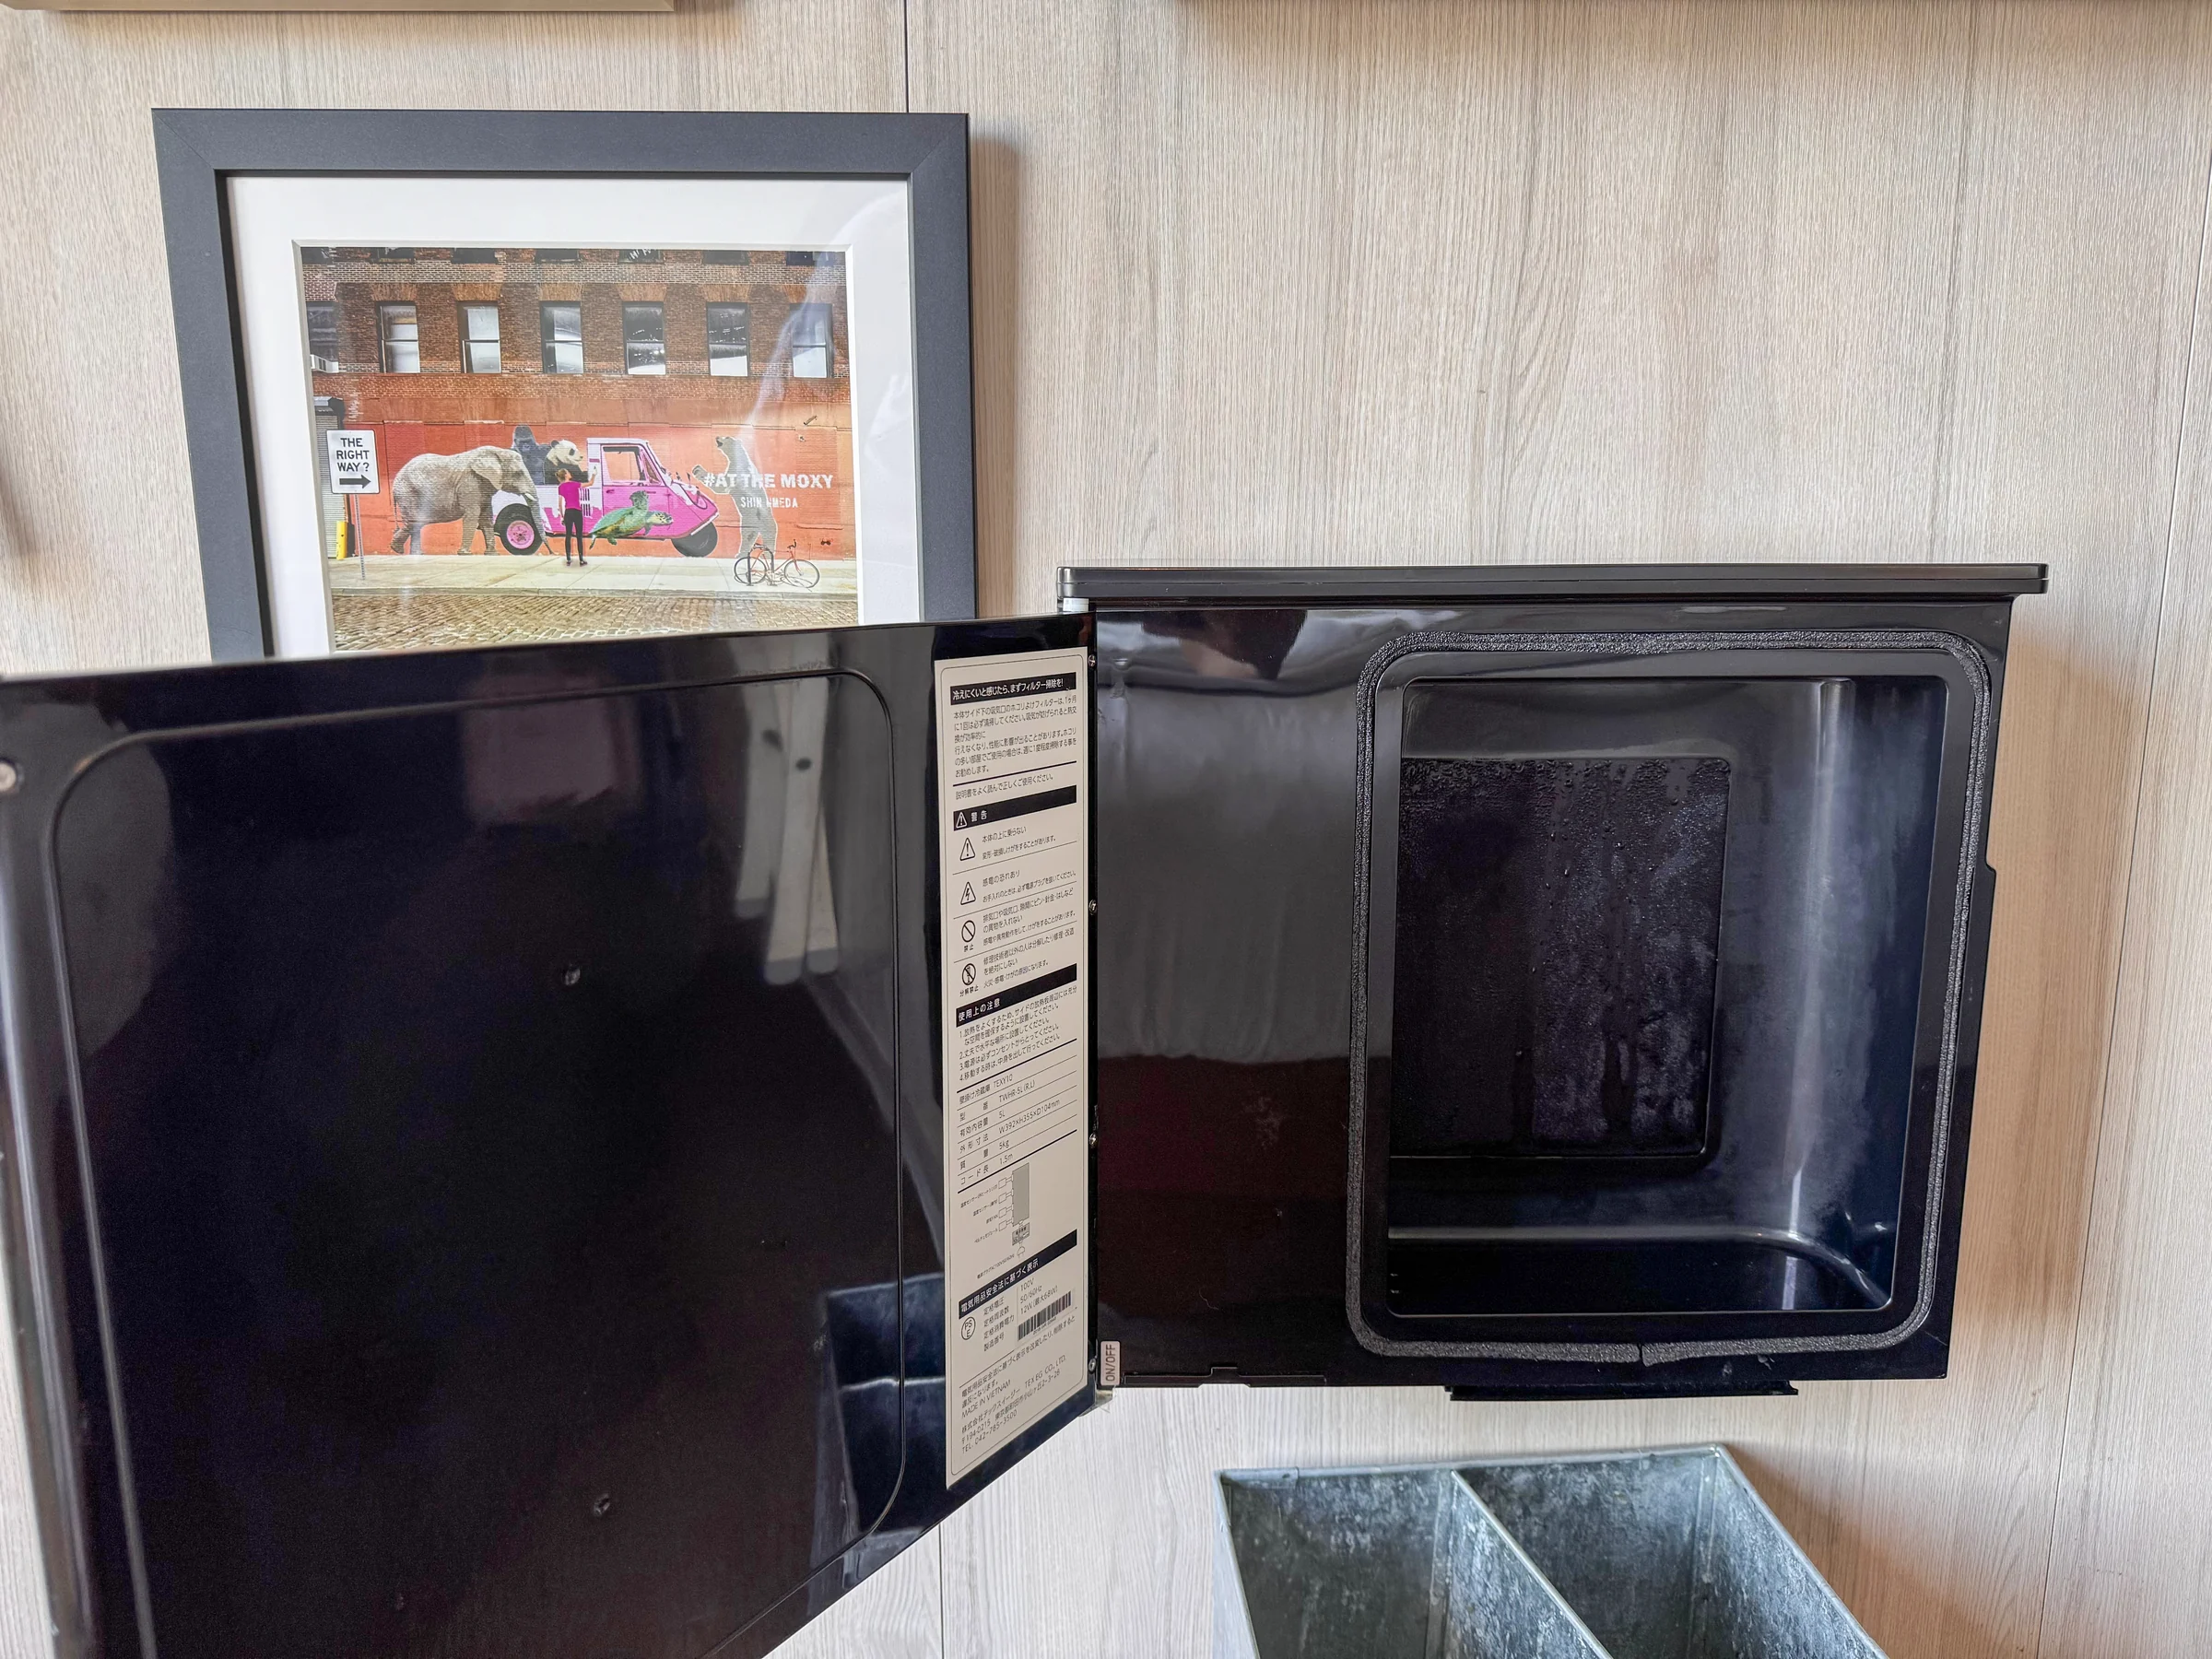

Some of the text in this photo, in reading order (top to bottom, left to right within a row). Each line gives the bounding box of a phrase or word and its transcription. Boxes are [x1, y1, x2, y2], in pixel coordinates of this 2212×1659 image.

[340, 437, 363, 448] THE
[335, 450, 370, 460] RIGHT
[703, 473, 833, 488] #AT THE MOXY
[740, 496, 762, 508] SHIN
[958, 997, 1001, 1022] 使用上の注意
[998, 1110, 1006, 1120] 5L
[999, 1139, 1010, 1150] 5kg
[999, 1153, 1014, 1165] 1.5m
[960, 1258, 1039, 1312] 電気用品安全法に基づく表示
[1105, 1344, 1116, 1382] ON/OFF
[961, 1379, 1011, 1418] MADE IN VIETNAM
